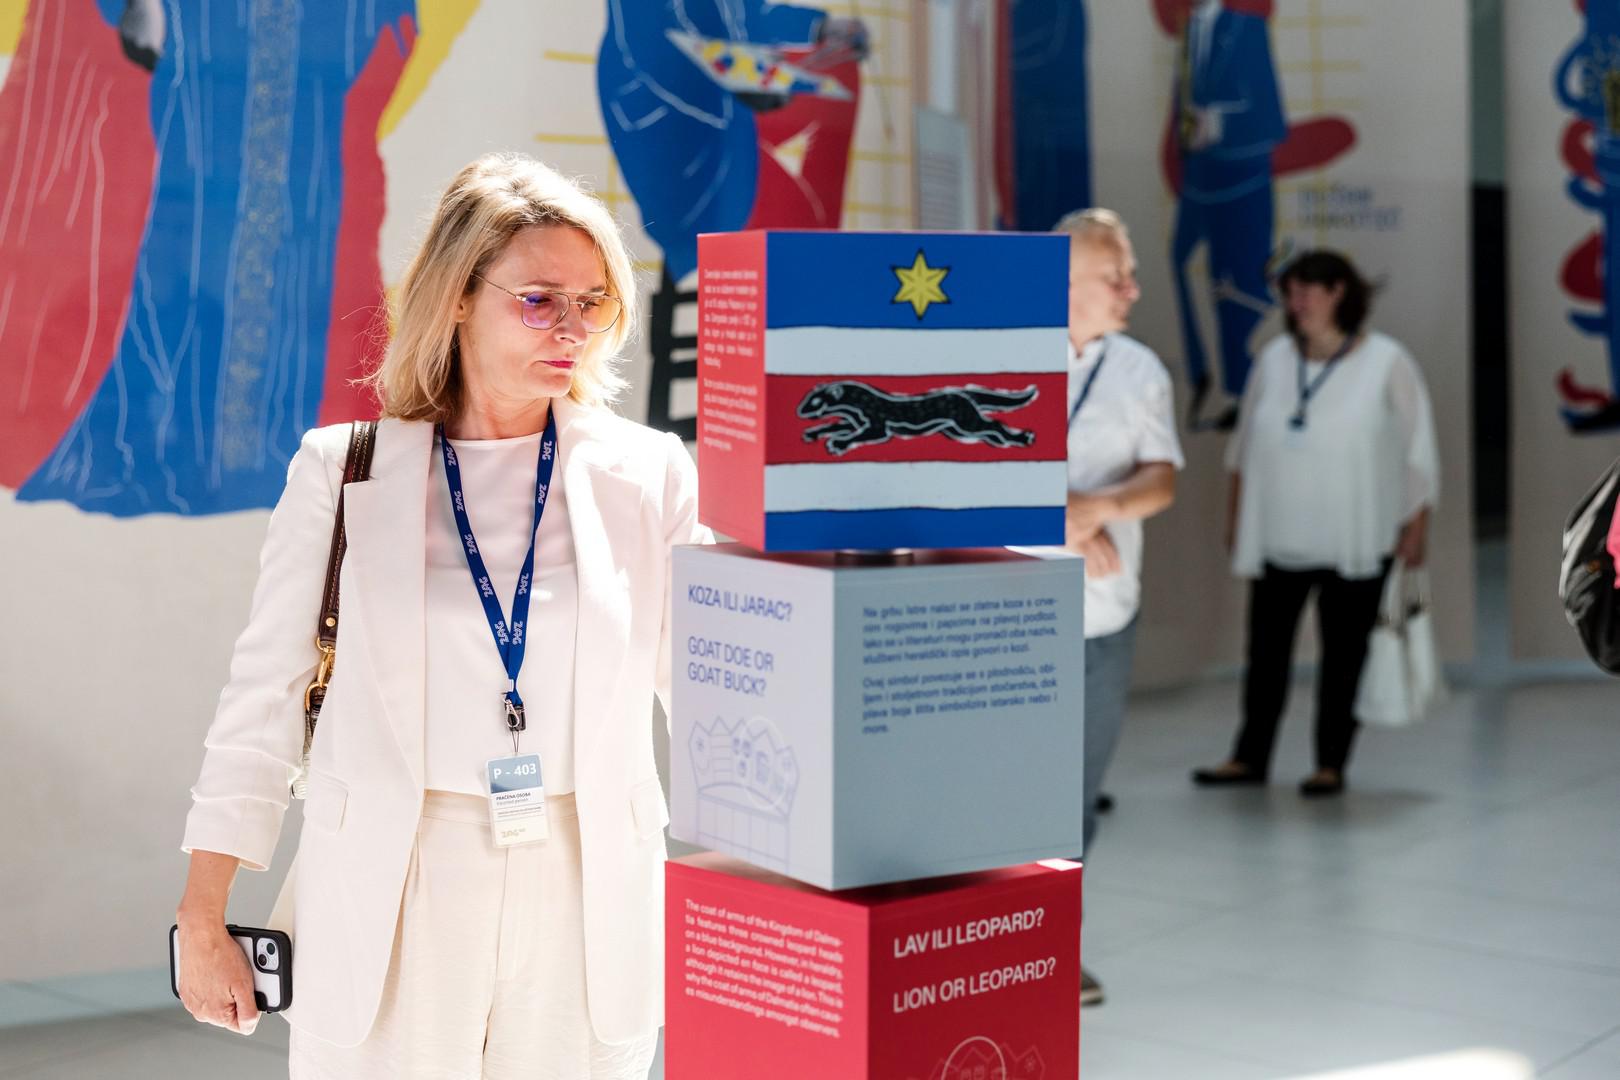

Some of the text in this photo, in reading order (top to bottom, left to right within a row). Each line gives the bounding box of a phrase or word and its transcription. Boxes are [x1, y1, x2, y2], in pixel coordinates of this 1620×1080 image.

[687, 584, 793, 622] KOZA ILI JARAC?
[687, 635, 774, 673] GOAT DOE OR
[687, 661, 767, 697] GOAT BUCK?
[494, 768, 502, 779] P
[514, 763, 537, 776] 403
[893, 907, 1046, 958] LAV ILI LEOPARD?
[893, 956, 1057, 1013] LION OR LEOPARD?
